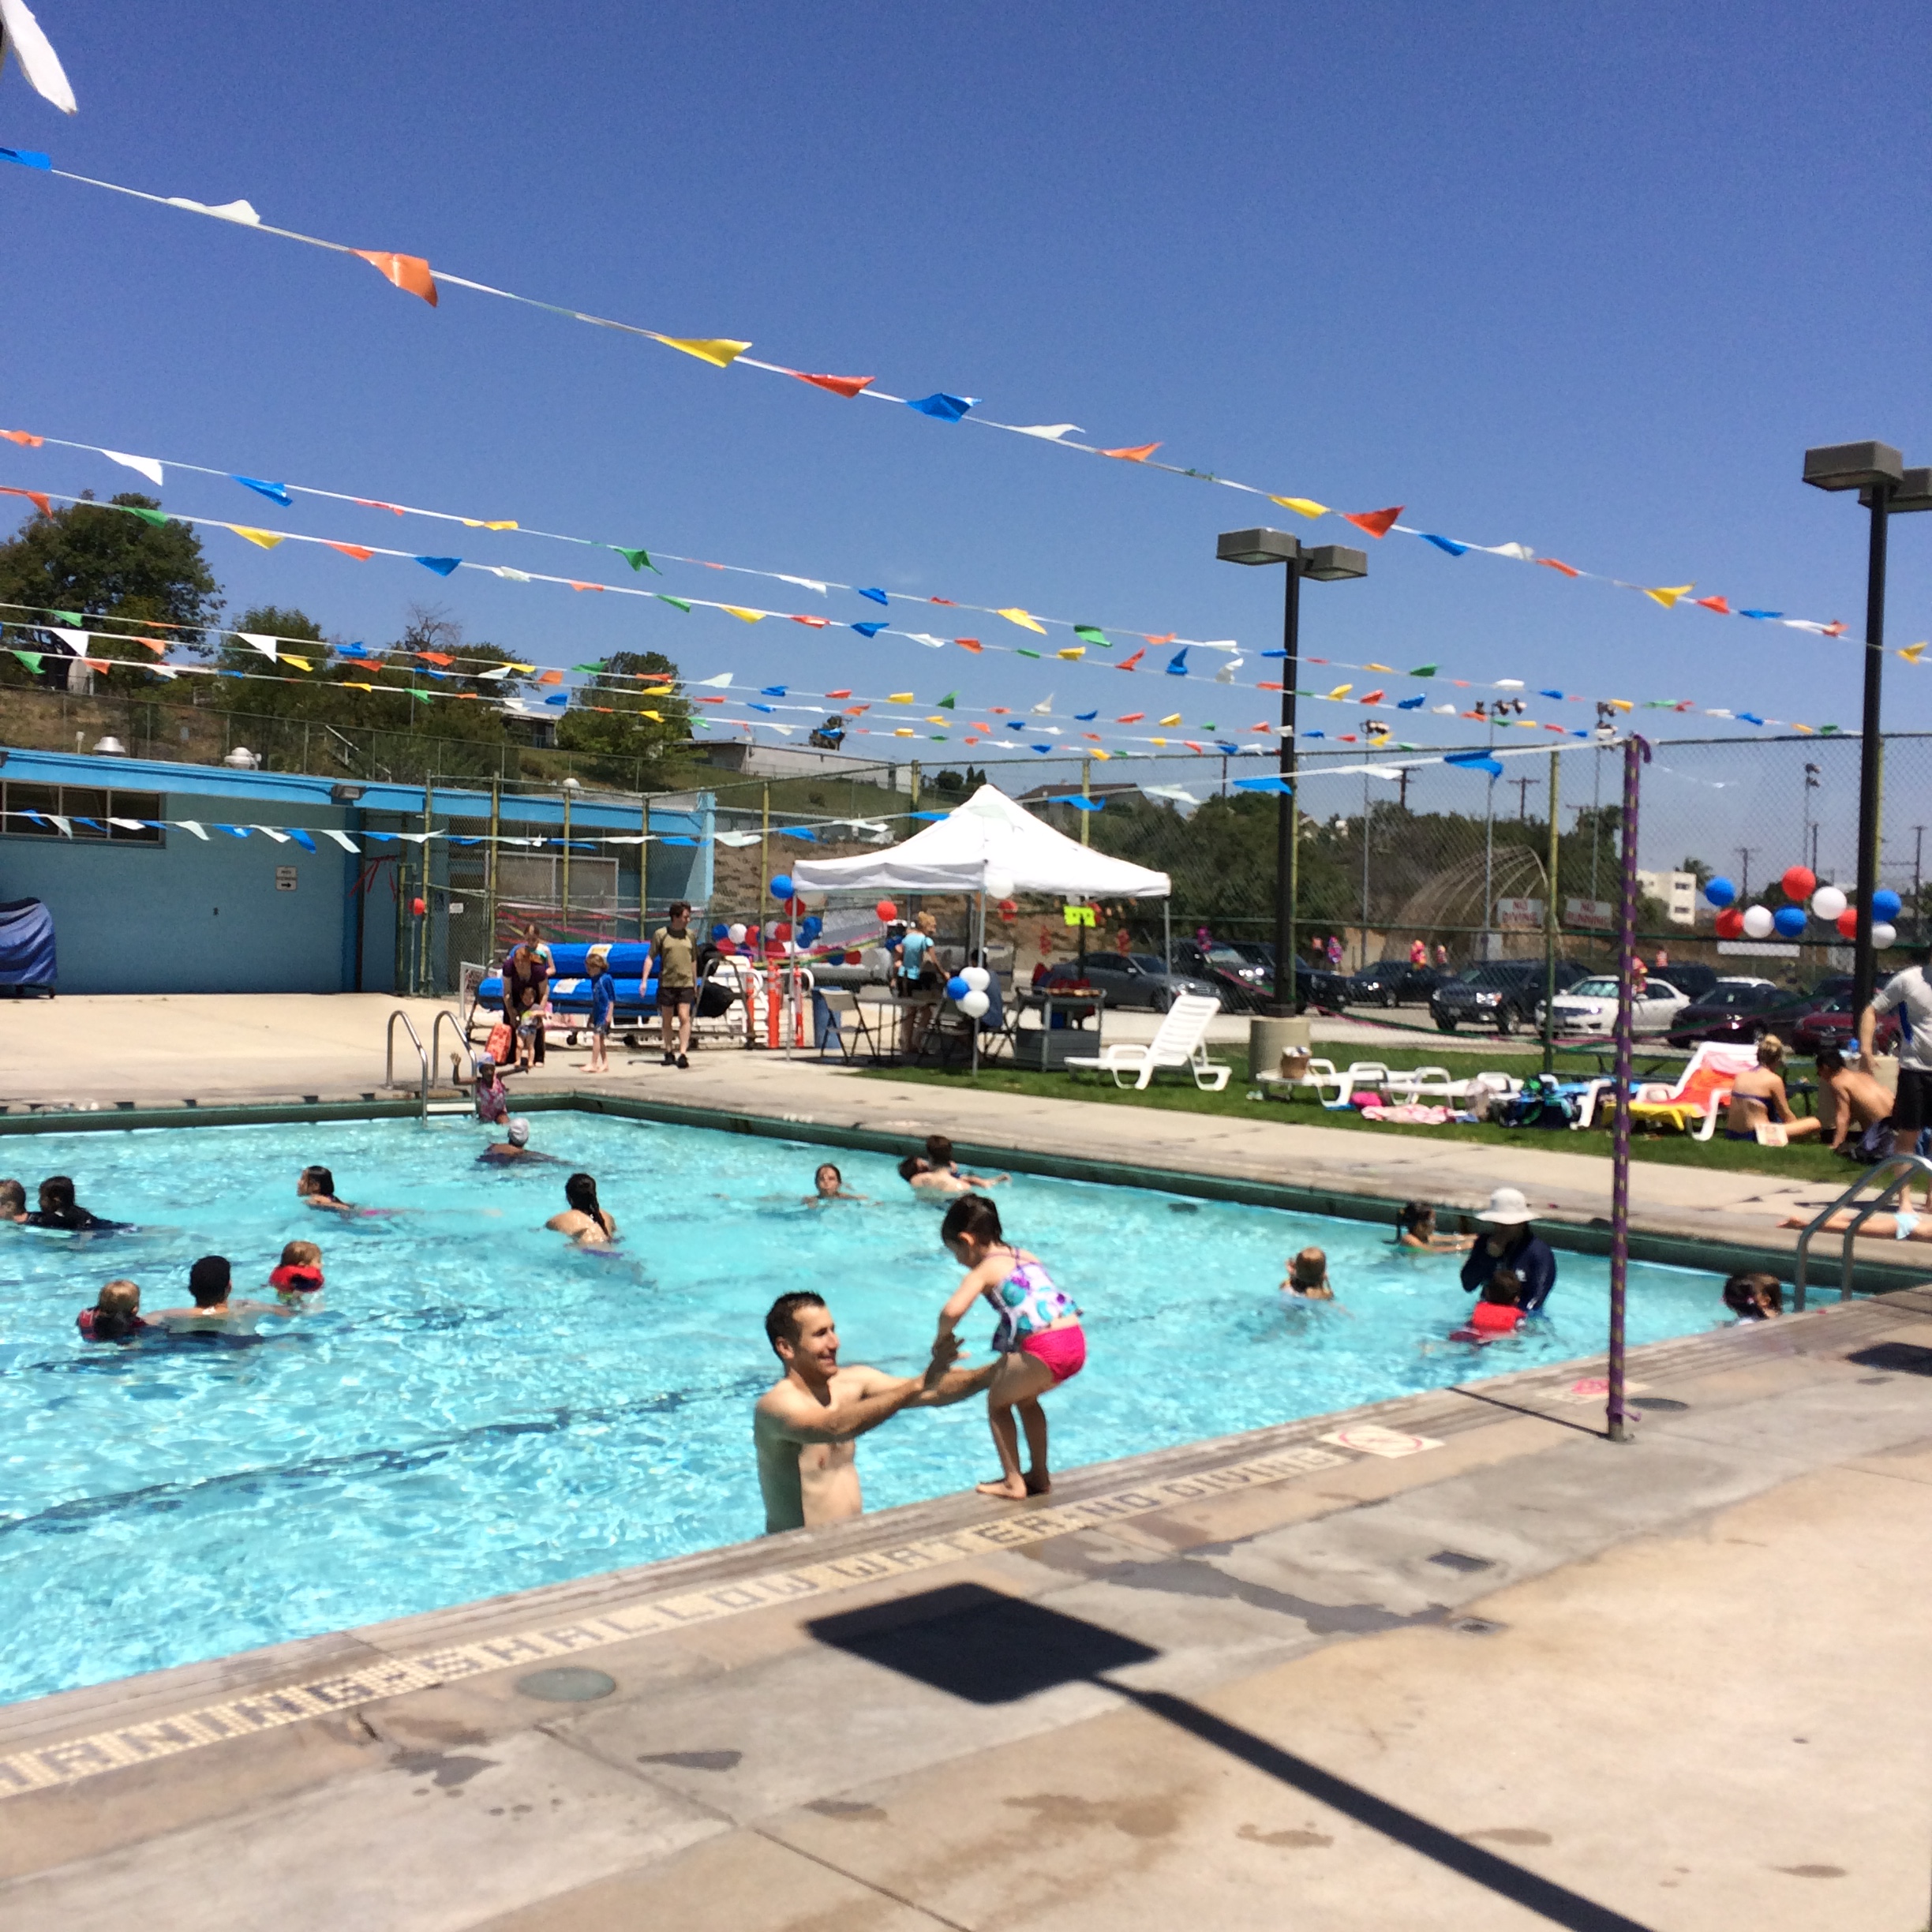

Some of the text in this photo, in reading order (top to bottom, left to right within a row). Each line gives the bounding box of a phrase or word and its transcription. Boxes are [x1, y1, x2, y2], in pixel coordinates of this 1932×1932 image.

[1513, 900, 1528, 911] NO
[0, 1679, 374, 1786] RNING
[419, 1576, 819, 1676] SHALLOW
[829, 1515, 1065, 1577] WATER
[1076, 1491, 1159, 1518] NO
[1160, 1449, 1334, 1499] DIVING
